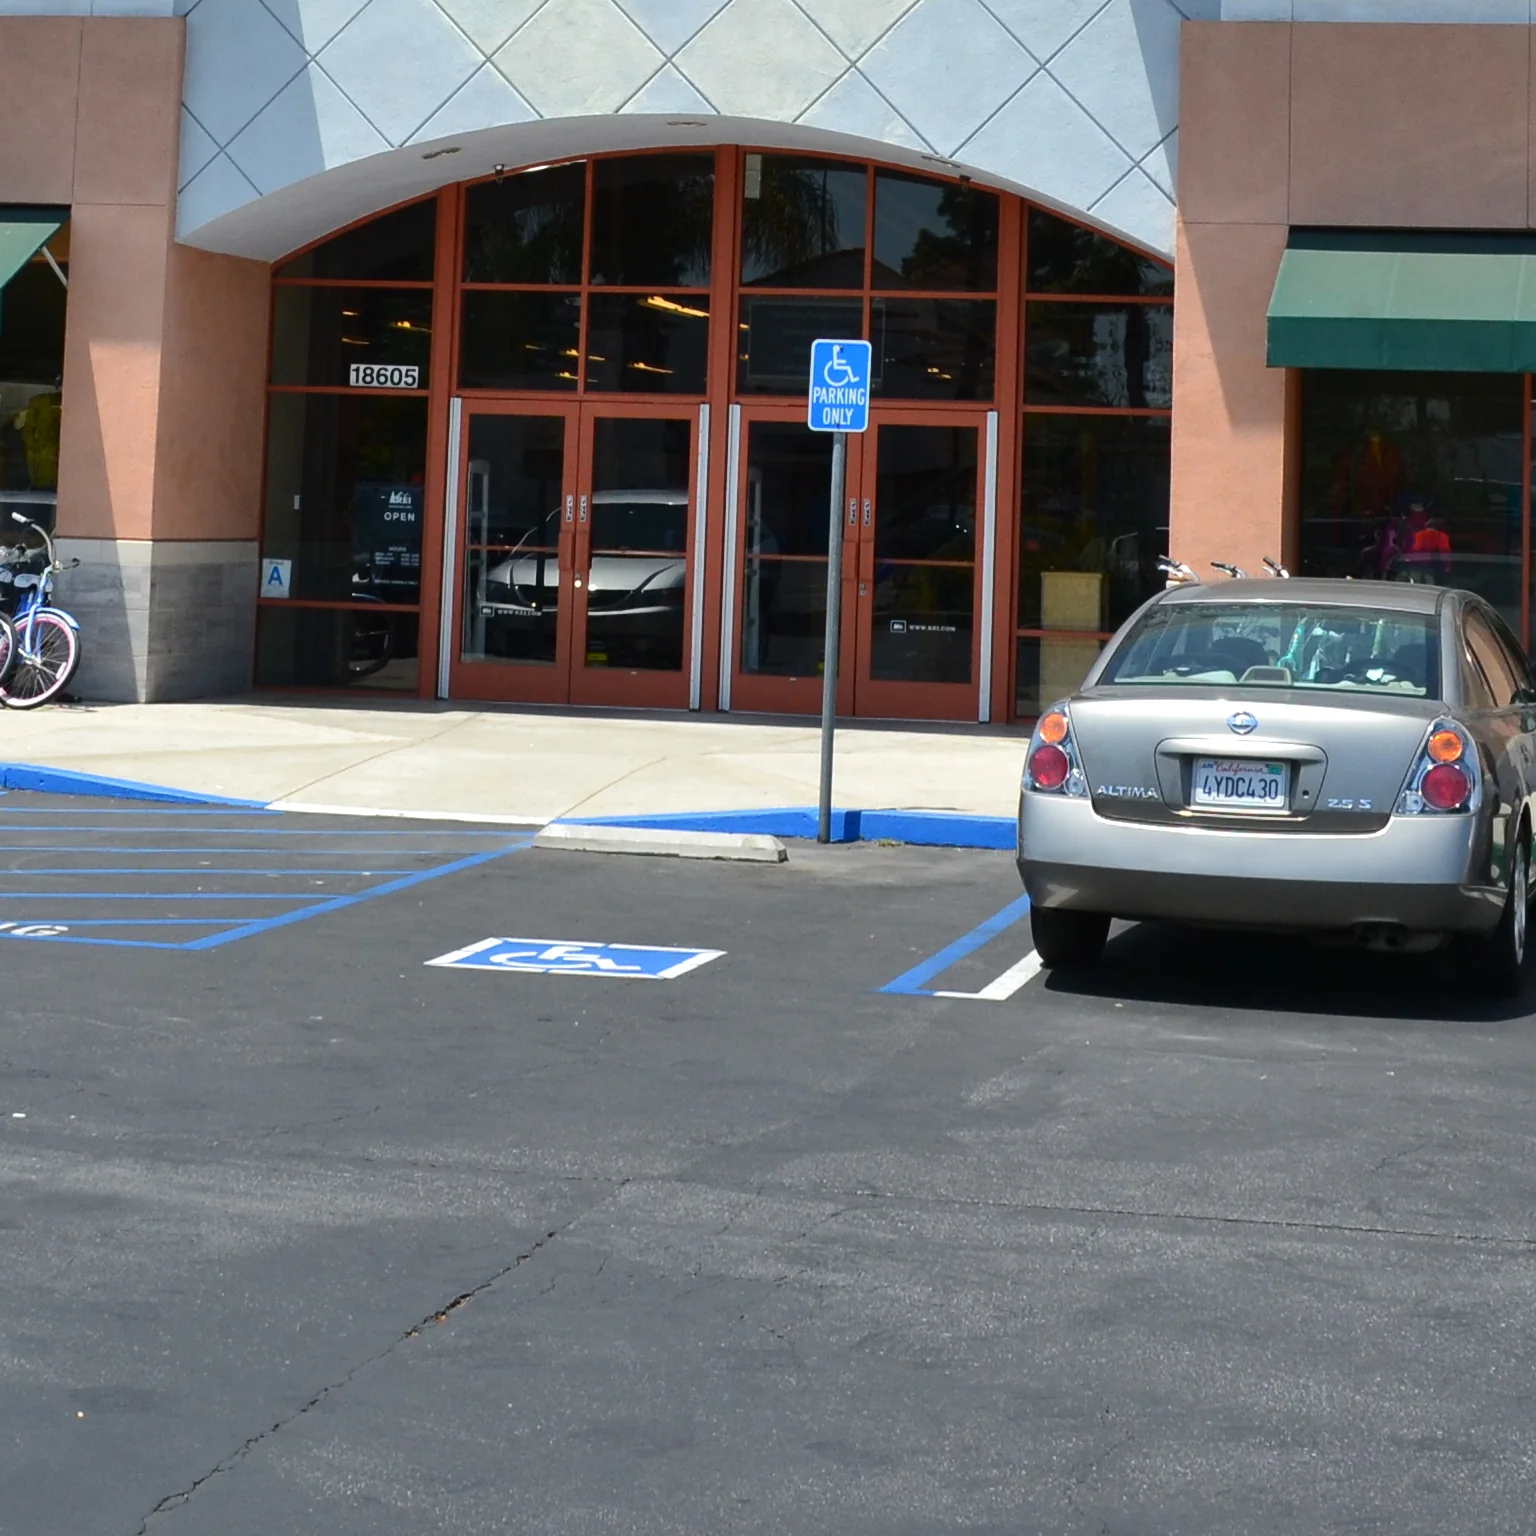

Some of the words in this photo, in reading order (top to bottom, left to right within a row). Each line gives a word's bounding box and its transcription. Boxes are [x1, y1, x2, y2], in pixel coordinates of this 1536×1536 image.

[352, 365, 418, 386] 18605
[813, 386, 865, 406] PARKING
[822, 407, 854, 426] ONLY
[384, 511, 415, 521] OPEN
[268, 566, 283, 585] A
[1215, 762, 1267, 776] California
[1096, 784, 1159, 800] ALTIMA
[1202, 775, 1279, 801] 4YDC430
[1358, 798, 1372, 810] S
